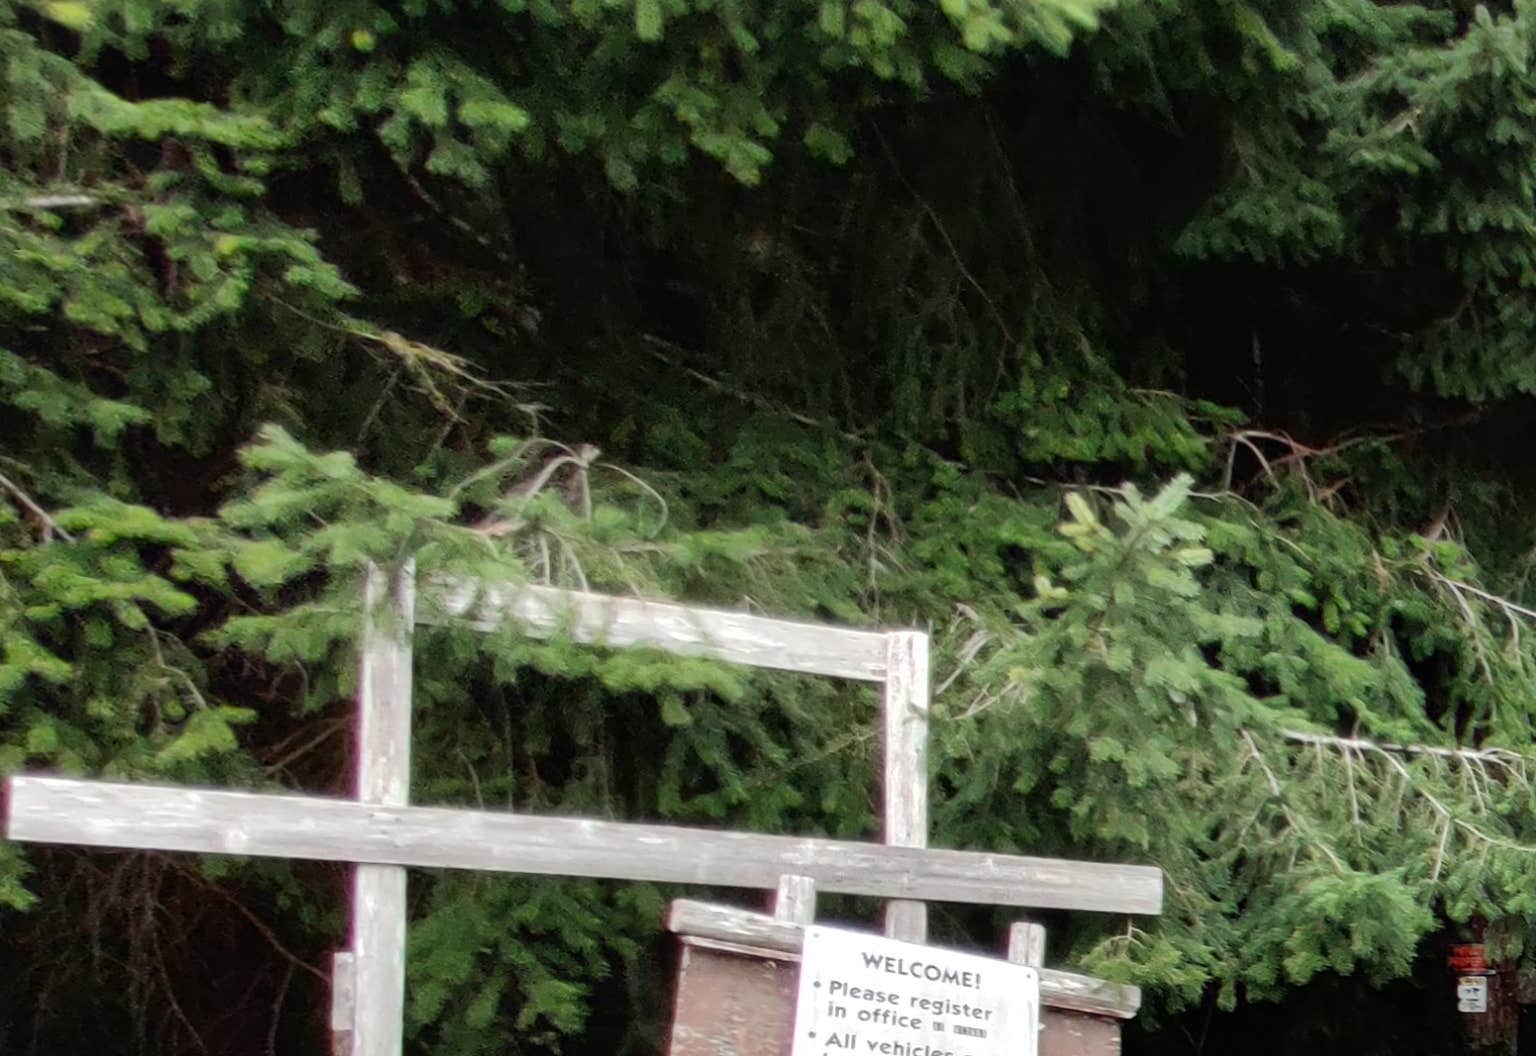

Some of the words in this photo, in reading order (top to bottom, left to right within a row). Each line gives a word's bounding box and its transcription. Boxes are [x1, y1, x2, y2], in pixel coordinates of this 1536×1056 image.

[862, 952, 981, 989] WELCOME!
[828, 1001, 846, 1018] in
[858, 1008, 922, 1030] office
[829, 980, 899, 1005] Please
[910, 997, 992, 1020] register
[825, 1033, 856, 1049] All
